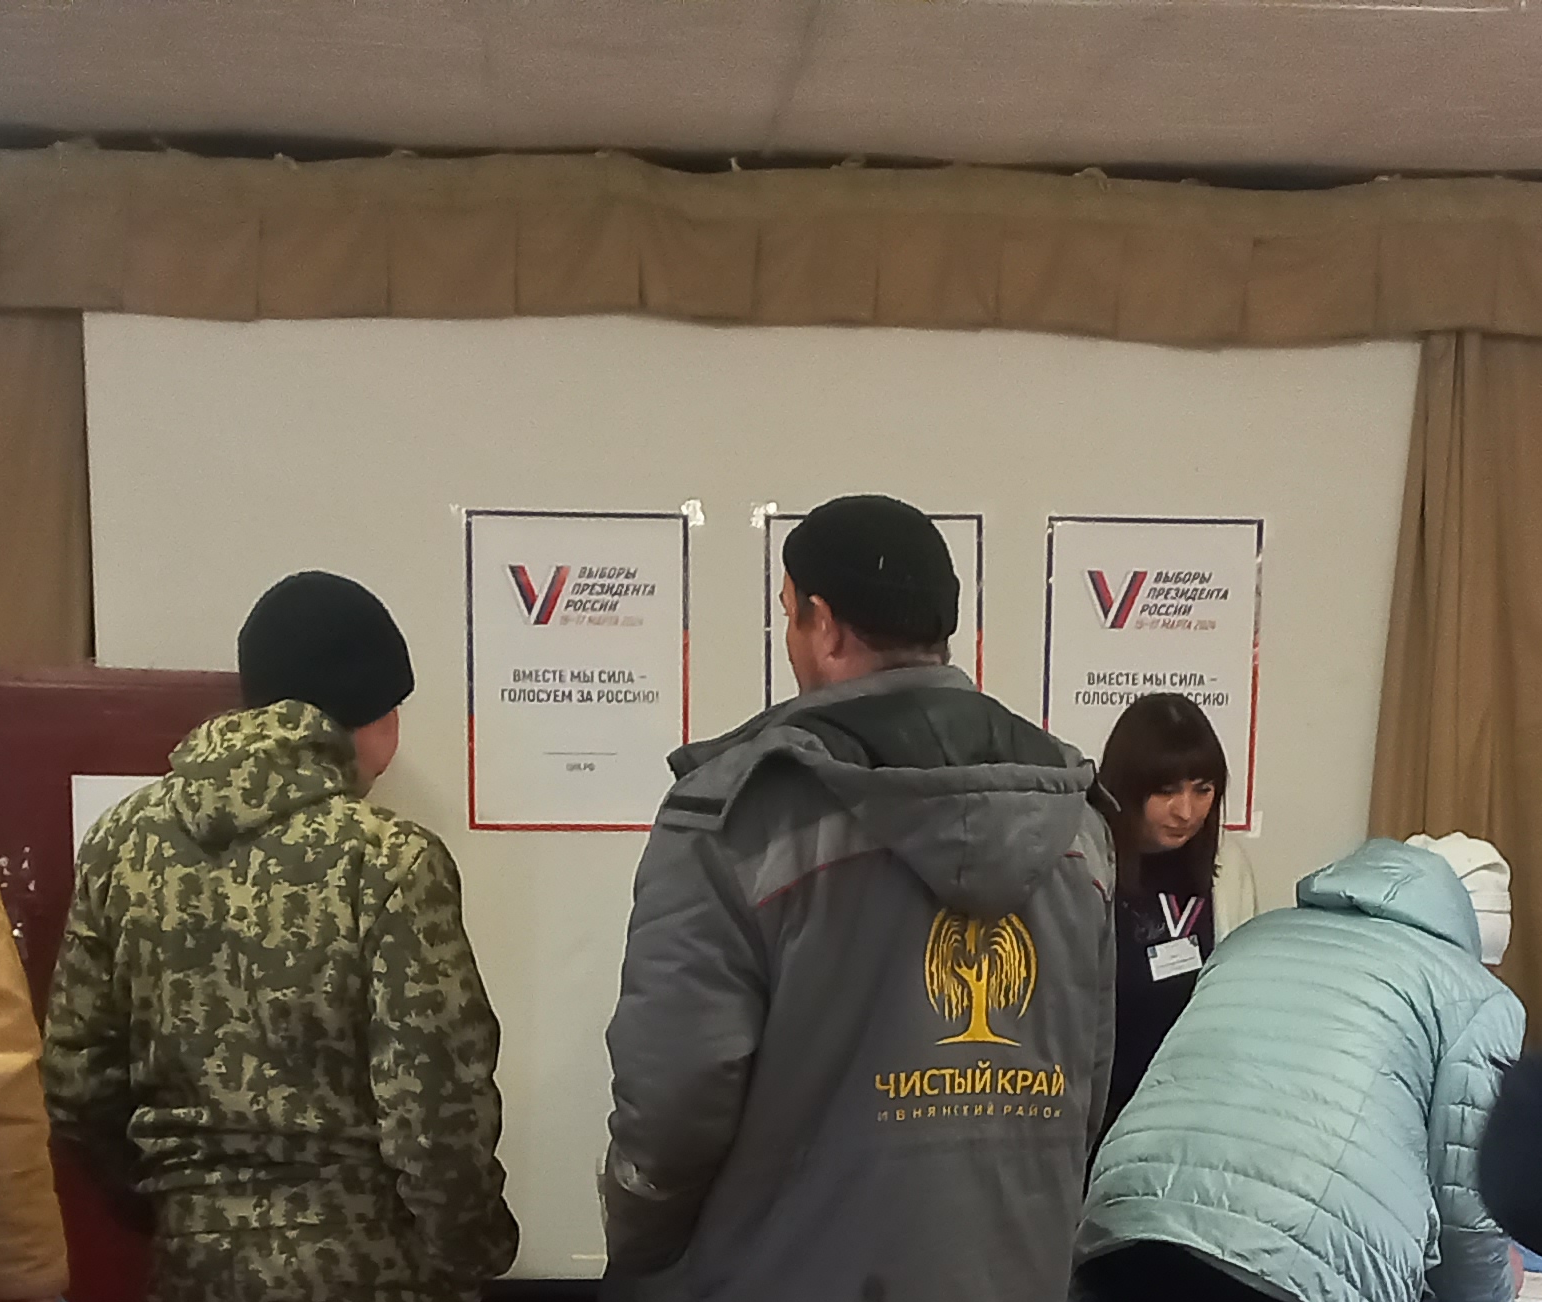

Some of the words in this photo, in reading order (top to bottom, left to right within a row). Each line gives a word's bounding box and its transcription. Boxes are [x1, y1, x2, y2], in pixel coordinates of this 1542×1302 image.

[578, 566, 638, 579] ВЫБОРЫ
[1153, 571, 1213, 584] ВЫБОРЫ
[571, 583, 656, 597] ПРЕЗИДЕНТА
[1146, 587, 1229, 601] ПРЕЗИДЕНТА
[564, 599, 620, 612] РОССИИ
[1140, 603, 1193, 616] РОССИИ
[512, 668, 566, 683] ВМЕСТЕ
[570, 669, 595, 684] МЫ
[598, 669, 635, 684] СИЛА
[1087, 671, 1139, 686] ВМЕСТЕ
[1143, 672, 1167, 686] МЫ
[1170, 672, 1205, 687] СИЛА
[501, 688, 573, 703] ГОЛОСУЕМ
[577, 689, 593, 703] ЗА
[597, 690, 660, 704] РОССИЮ!
[875, 1059, 992, 1098] ЧИСТЫЙ
[996, 1064, 1066, 1097] КРАЙ
[877, 1101, 995, 1122] ИВНЯНСКИЙ
